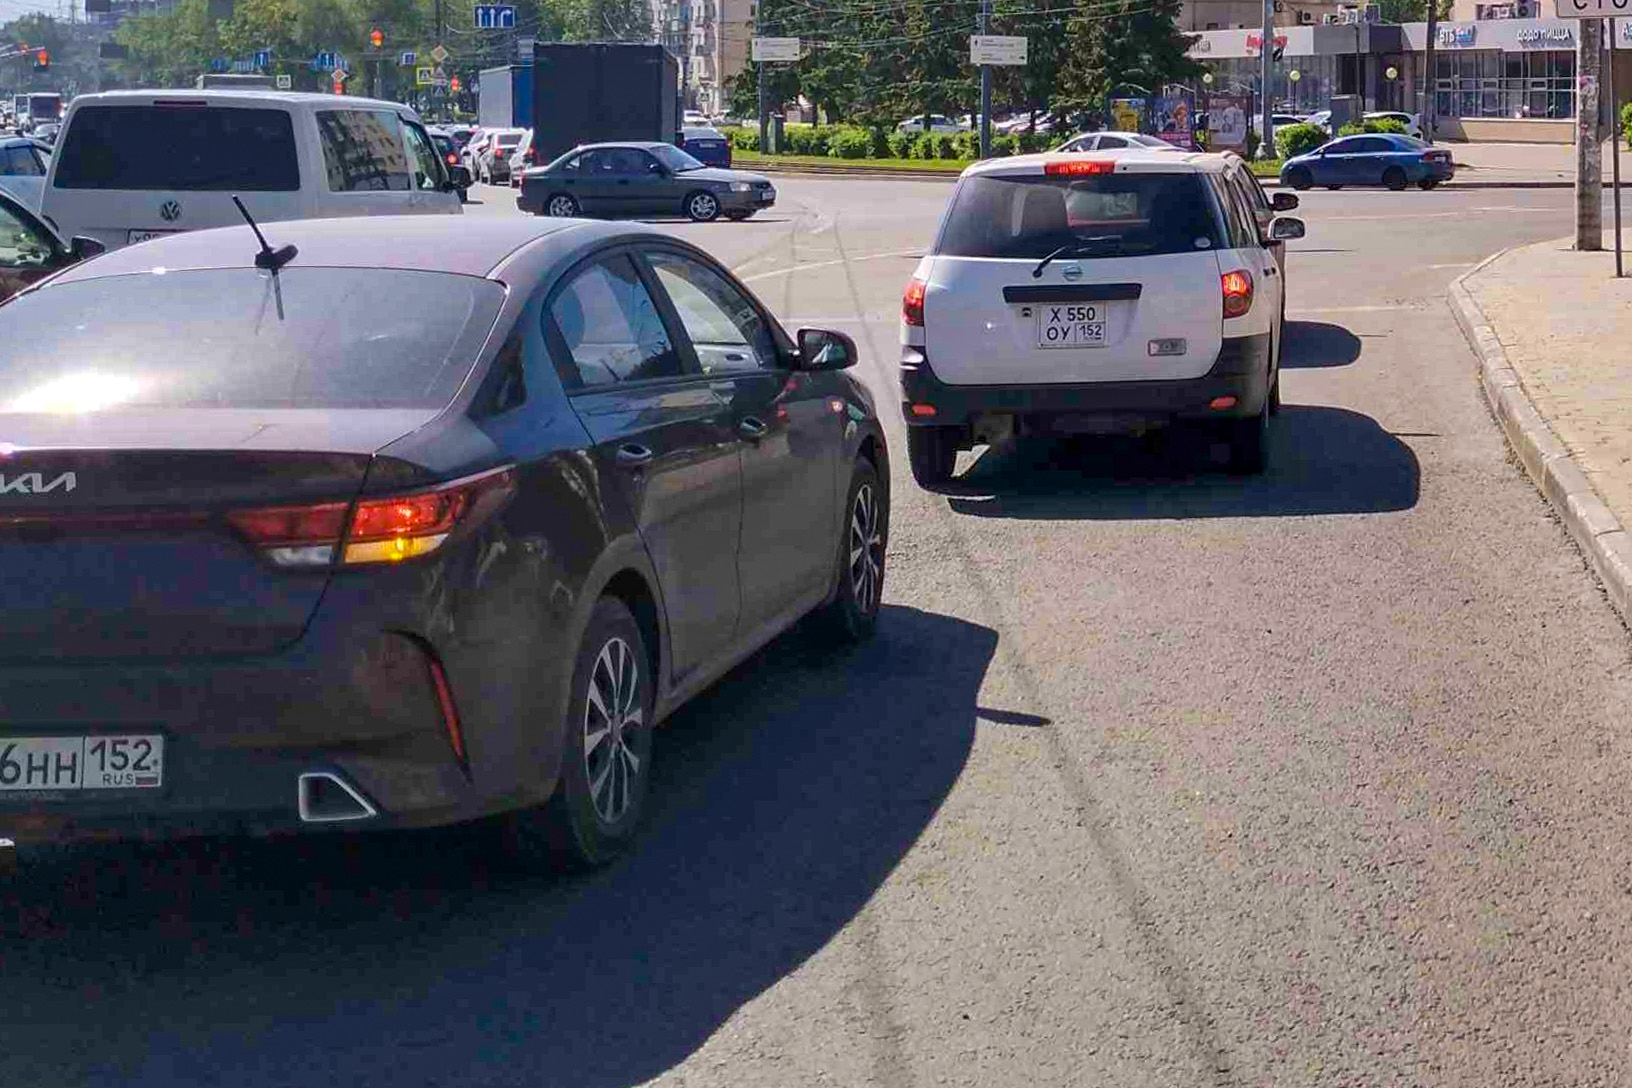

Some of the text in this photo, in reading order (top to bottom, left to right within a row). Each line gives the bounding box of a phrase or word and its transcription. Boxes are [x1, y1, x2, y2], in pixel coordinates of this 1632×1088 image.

[1439, 28, 1455, 43] ВТБ
[1067, 306, 1096, 322] 550
[1078, 324, 1103, 337] 152
[90, 738, 152, 772] 152
[103, 773, 134, 786] RUS
